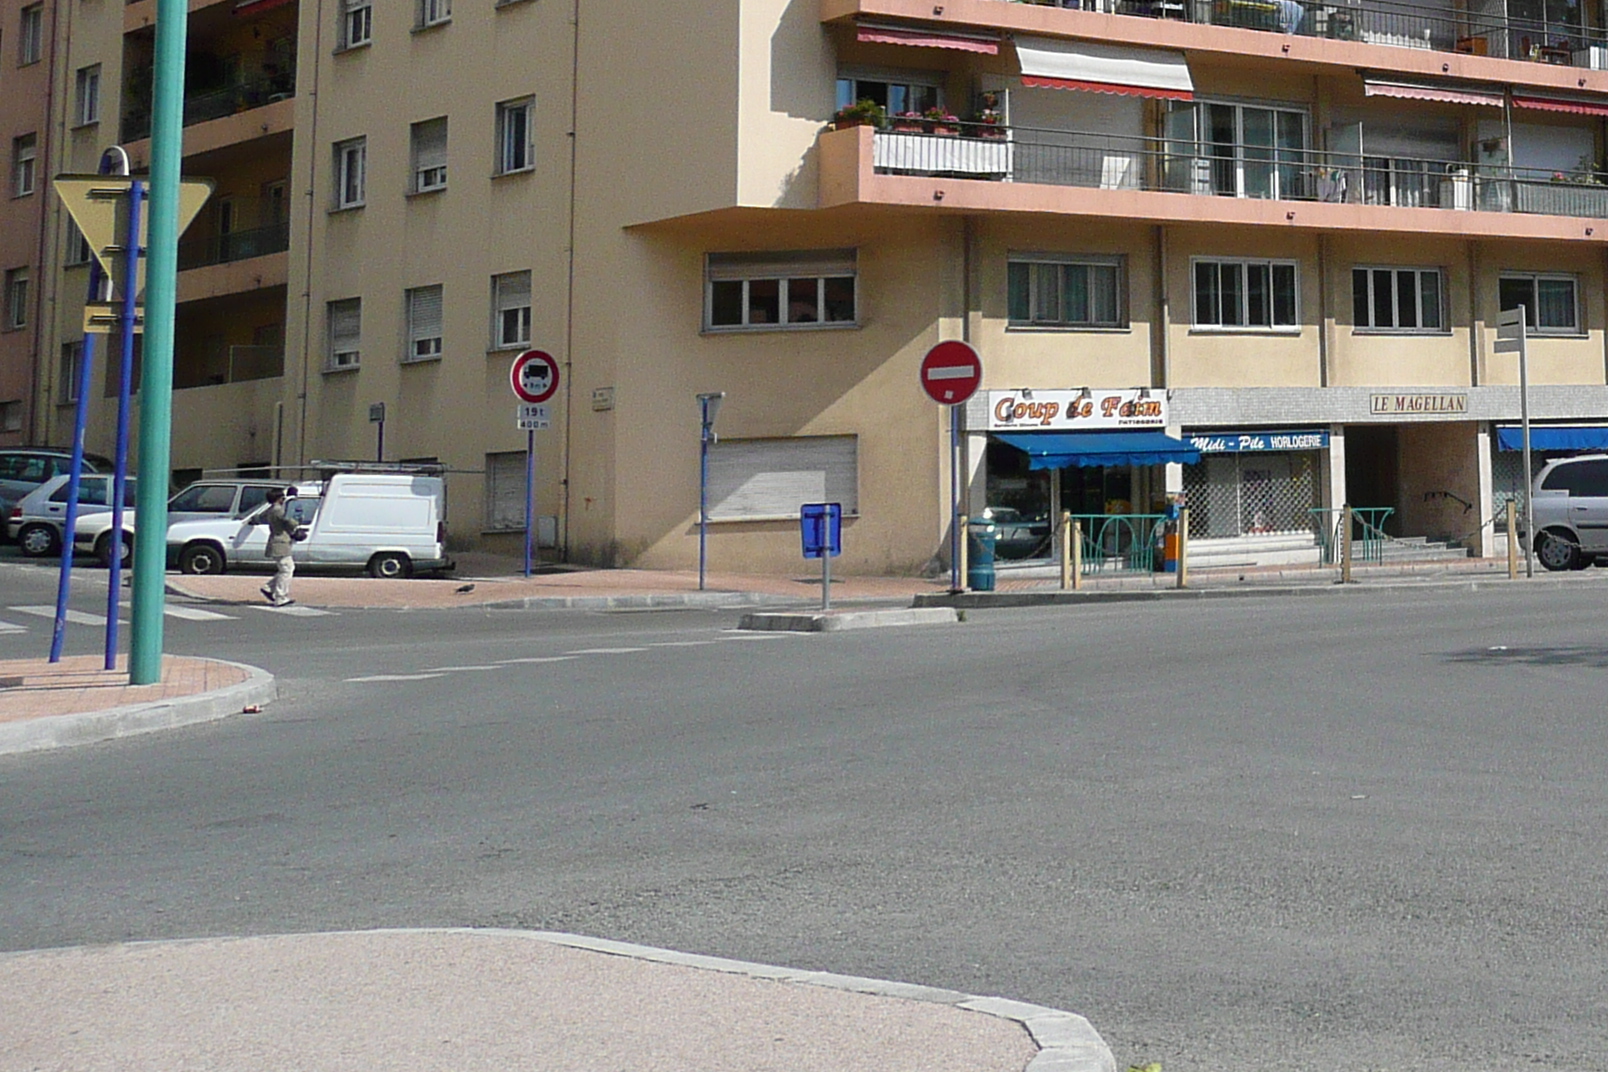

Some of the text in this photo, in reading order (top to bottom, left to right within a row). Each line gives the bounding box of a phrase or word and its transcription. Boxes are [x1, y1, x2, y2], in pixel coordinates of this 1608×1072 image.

[995, 395, 1162, 426] Coup de Faim
[1374, 395, 1465, 411] LE MAGELLAN
[1190, 436, 1226, 450] Midi
[1238, 435, 1265, 450] Pile
[1270, 434, 1322, 448] HORLOGERIE
